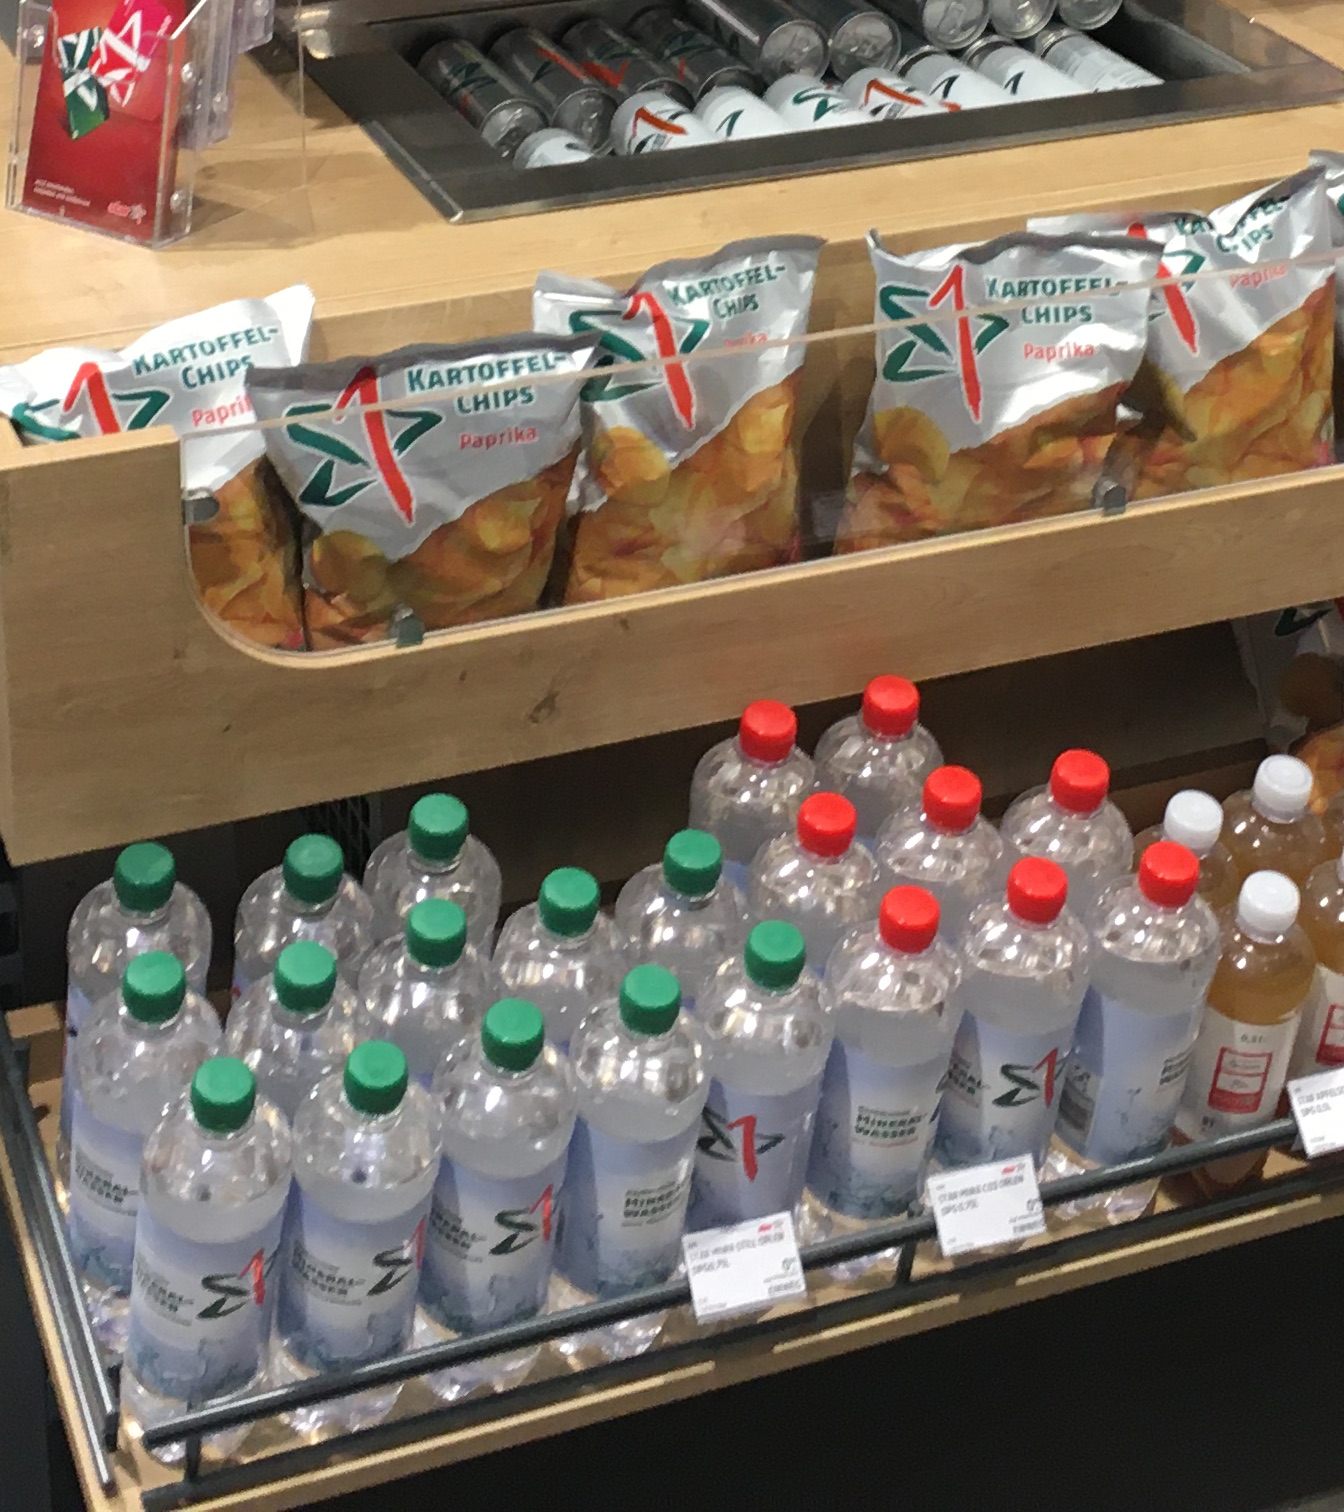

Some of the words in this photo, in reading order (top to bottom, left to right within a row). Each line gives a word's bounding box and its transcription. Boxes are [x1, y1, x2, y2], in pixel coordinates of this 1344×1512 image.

[667, 263, 787, 307] KARTOFFEL-
[985, 276, 1129, 299] KARTOFFEL-
[712, 294, 760, 319] CHIPS
[1020, 305, 1094, 325] CHIPS
[133, 327, 280, 376] KARTOFFEL-
[1023, 341, 1096, 363] Paprika
[181, 355, 255, 389] CHIPS
[406, 353, 567, 393] KARTOFFEL-
[192, 396, 253, 428] Papri
[455, 385, 536, 415] CHIPS
[460, 427, 538, 450] Paprika
